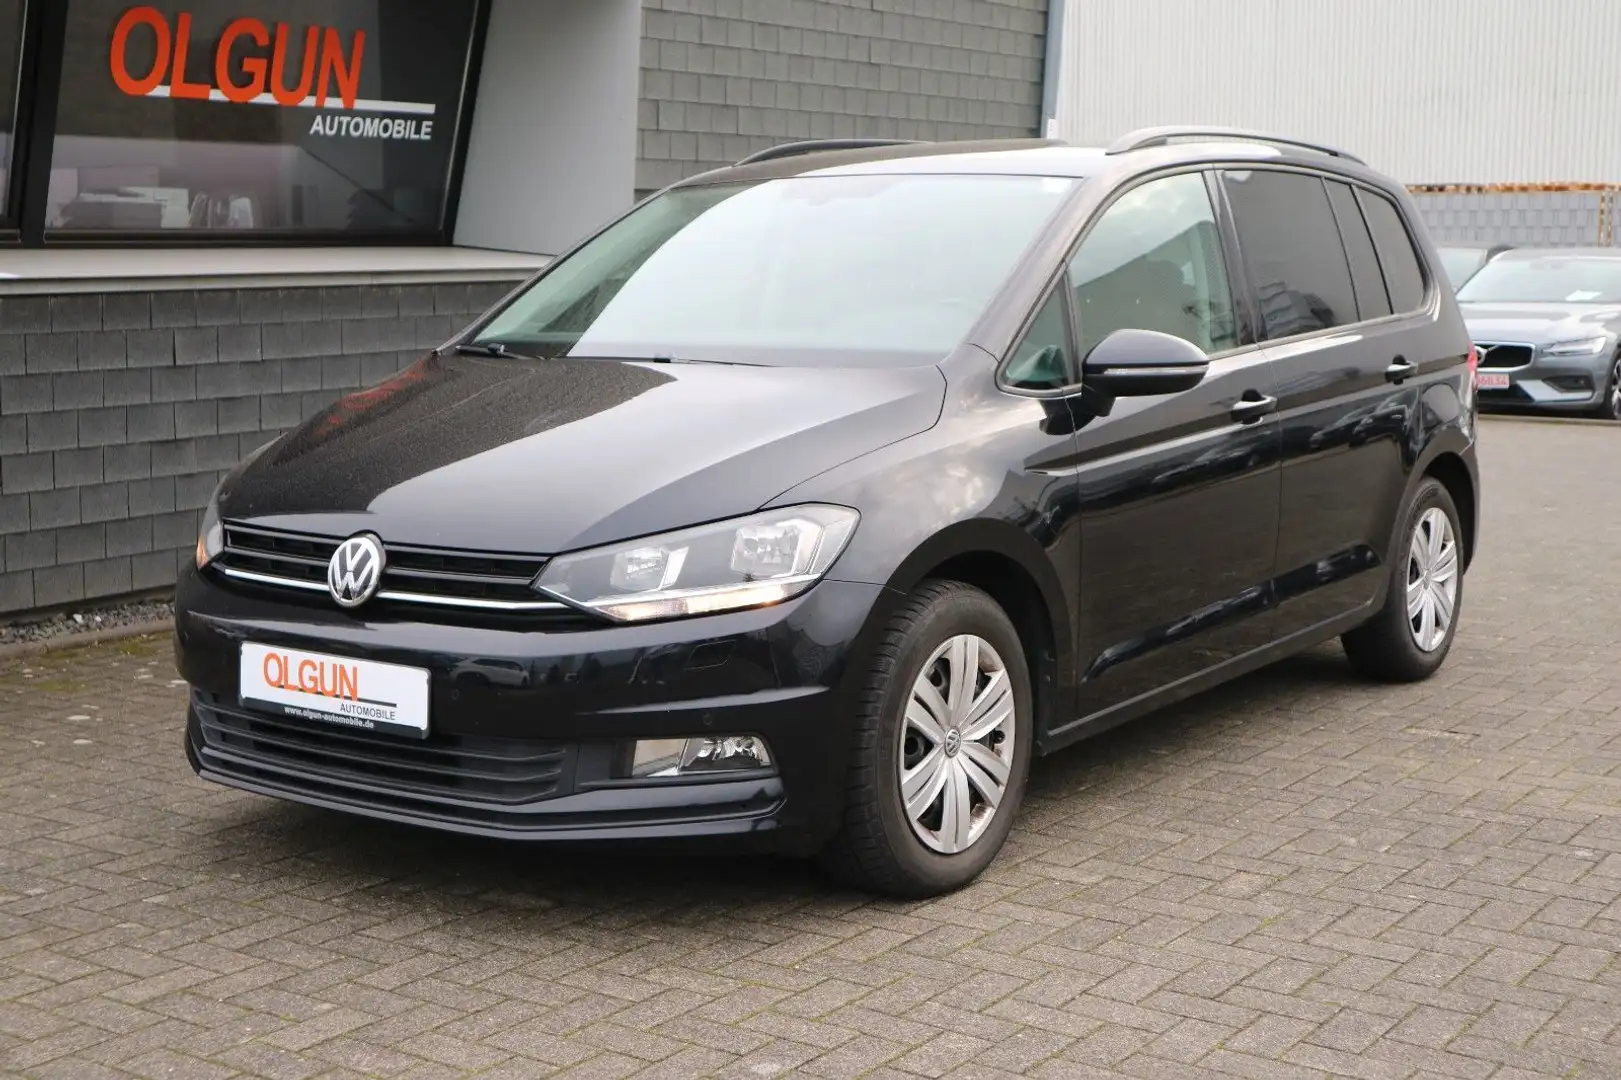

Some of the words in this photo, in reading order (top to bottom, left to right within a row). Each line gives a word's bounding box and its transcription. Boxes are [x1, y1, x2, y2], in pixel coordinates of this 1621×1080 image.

[110, 5, 366, 109] OLGUN
[310, 114, 433, 140] AUTOMOBILE
[329, 537, 381, 605] VW
[263, 652, 359, 701] OLGUN
[284, 706, 375, 729] www.olgun-automobile.de
[340, 703, 396, 720] AUTOMOBILE
